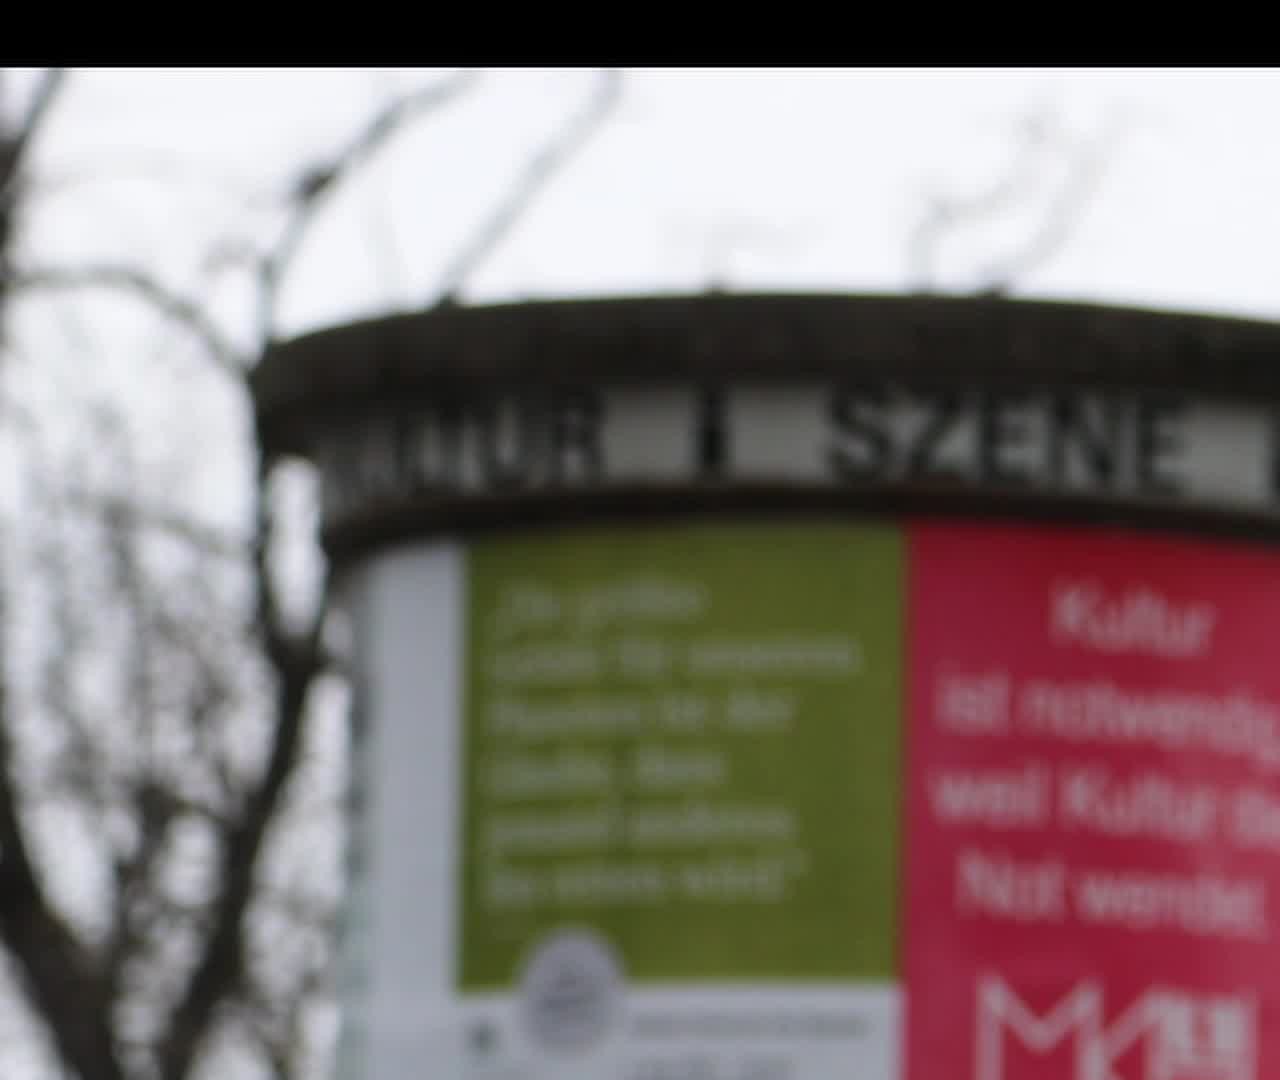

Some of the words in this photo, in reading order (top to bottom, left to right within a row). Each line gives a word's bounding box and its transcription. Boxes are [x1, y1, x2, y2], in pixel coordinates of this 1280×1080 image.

[828, 390, 1196, 496] SZENE
[1050, 580, 1216, 656] Kultur
[936, 672, 1011, 734] ist
[930, 766, 1047, 826] weil
[1061, 774, 1216, 844] Kultur
[957, 850, 1066, 926] Not
